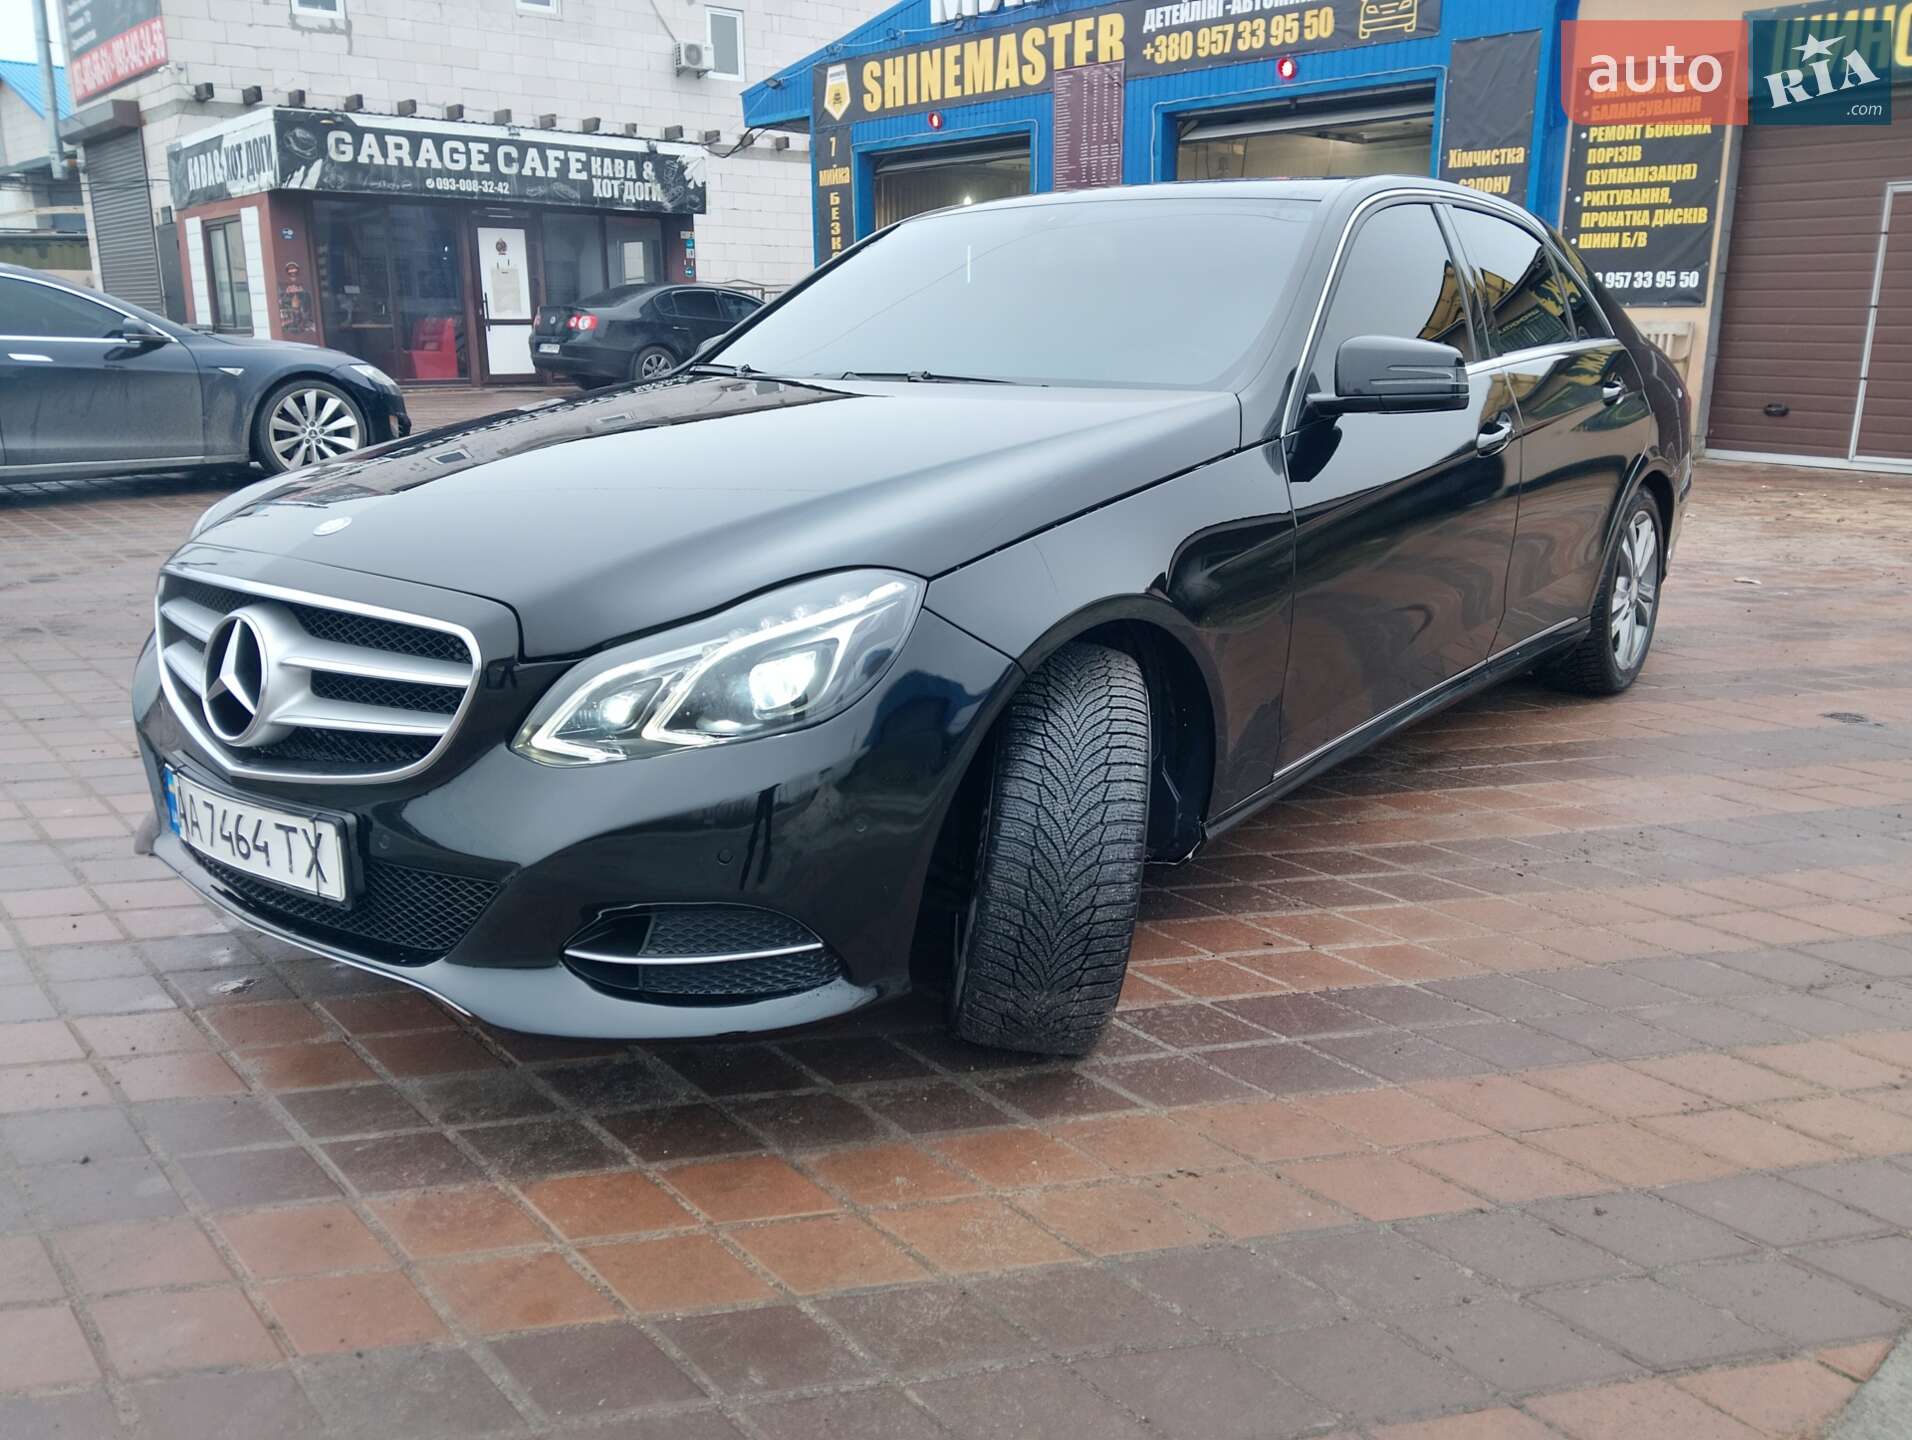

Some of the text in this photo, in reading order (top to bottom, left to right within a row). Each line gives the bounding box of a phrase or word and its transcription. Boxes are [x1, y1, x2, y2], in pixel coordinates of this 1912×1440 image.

[1143, 6, 1335, 64] +380 957 33 95 50
[863, 13, 1125, 112] SHINEMASTER
[1589, 117, 1712, 142] РЕМОНТ БОКОВИХ
[327, 130, 588, 180] GARAGE CAFE
[1448, 147, 1525, 168] Хімчистка
[1587, 145, 1642, 164] ПОРІЗІВ
[591, 156, 636, 179] КАВА
[1586, 163, 1698, 185] (ВУЛКАНІЗАЦІЯ)
[1583, 187, 1672, 206] РИХТУВАННЯ,
[1580, 207, 1708, 228] ПРОКАТКА ДИСКІВ
[1578, 231, 1648, 249] ШИНИ Б/В
[1605, 272, 1631, 288] 957
[1633, 271, 1653, 288] 33
[1655, 271, 1677, 288] 95
[1679, 271, 1699, 288] 50
